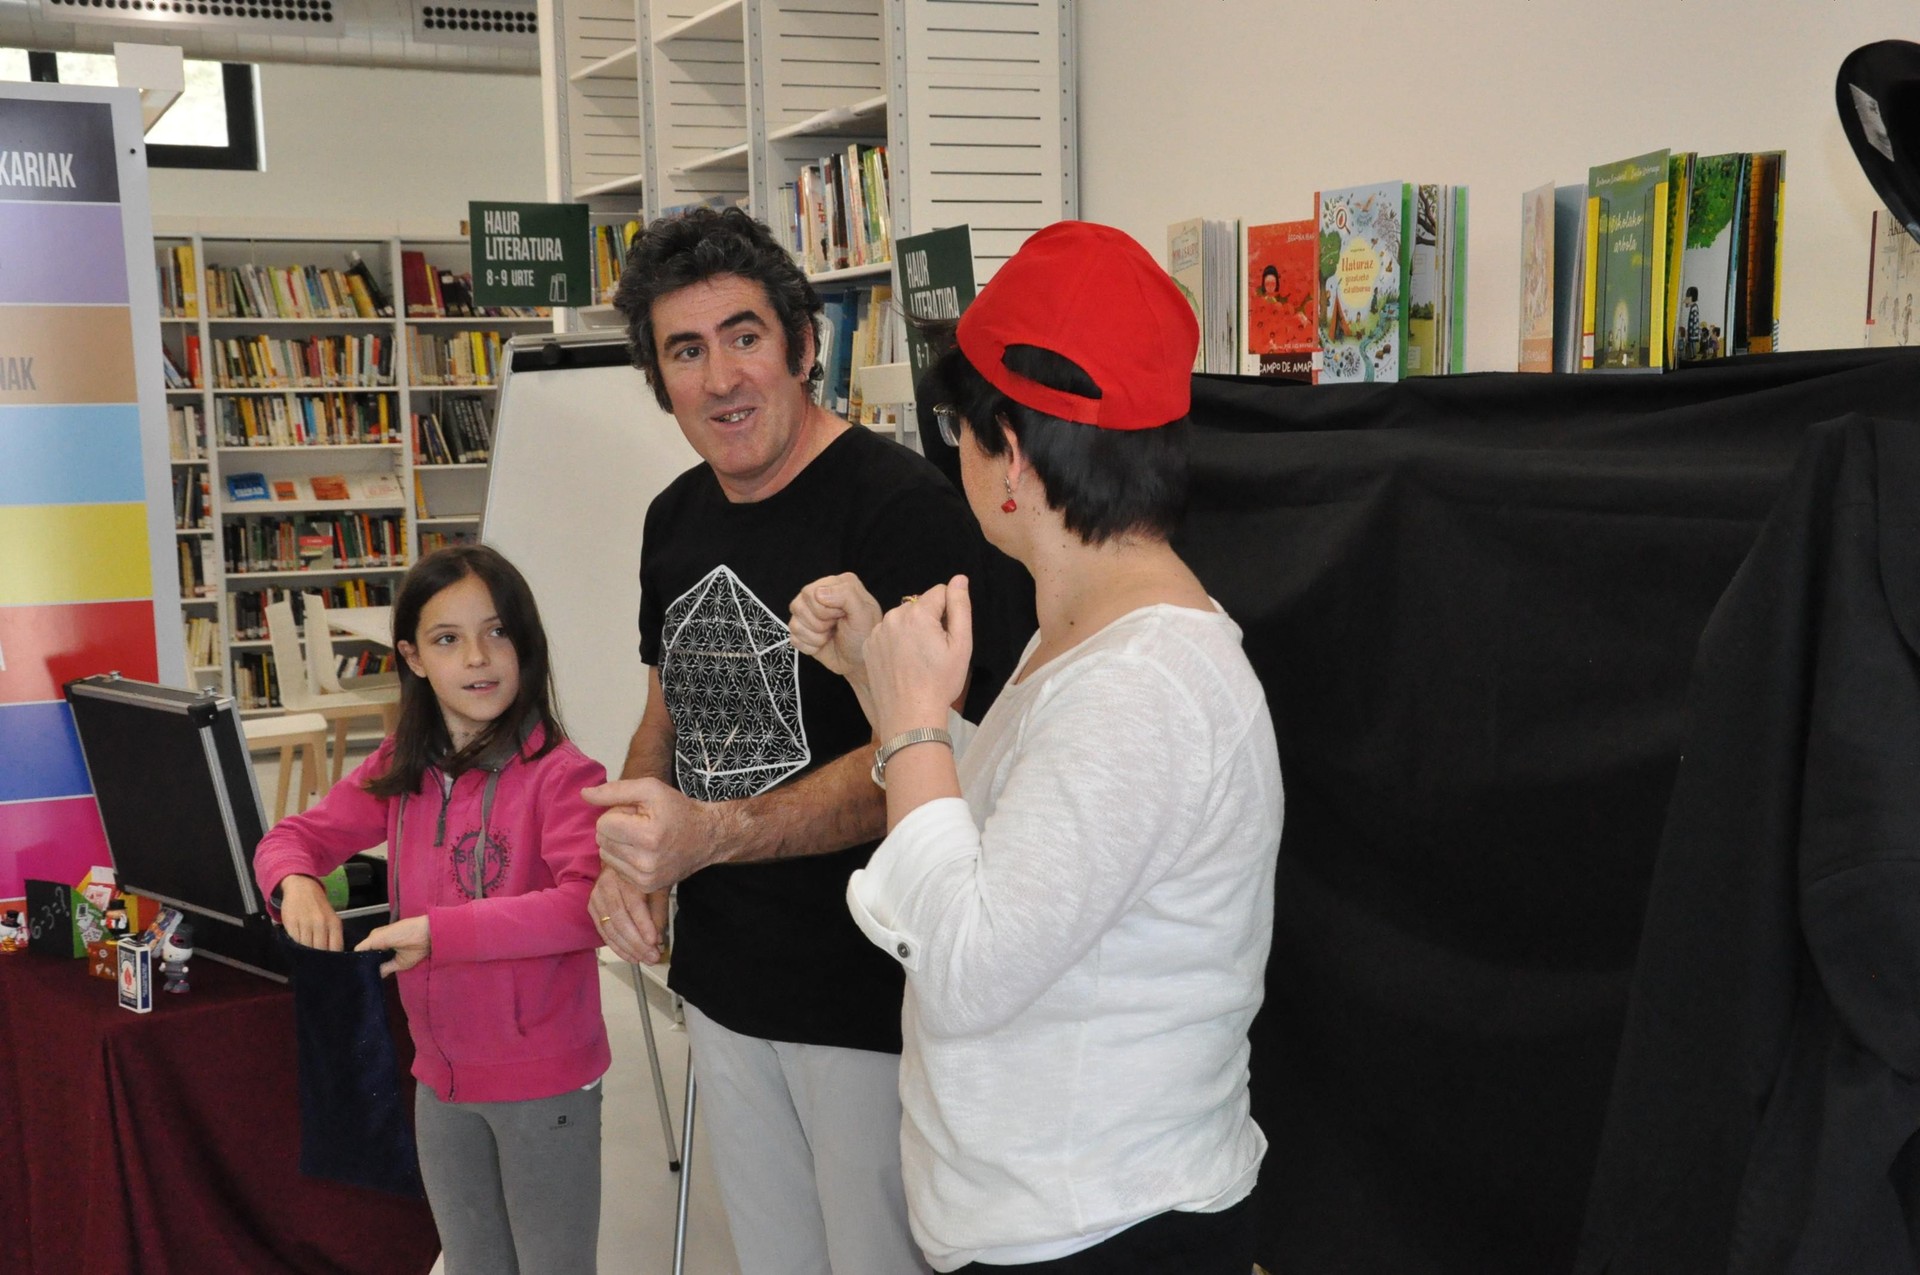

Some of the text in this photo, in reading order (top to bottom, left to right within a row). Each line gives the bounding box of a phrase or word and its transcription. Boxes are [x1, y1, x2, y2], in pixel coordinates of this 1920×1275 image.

[484, 210, 520, 235] HAUR
[485, 236, 564, 262] LITERATURA
[511, 269, 535, 287] URTE
[905, 249, 930, 289] HAUR
[910, 286, 961, 320] LITERATURA
[1260, 362, 1281, 374] CAMPO
[1282, 361, 1292, 373] DE
